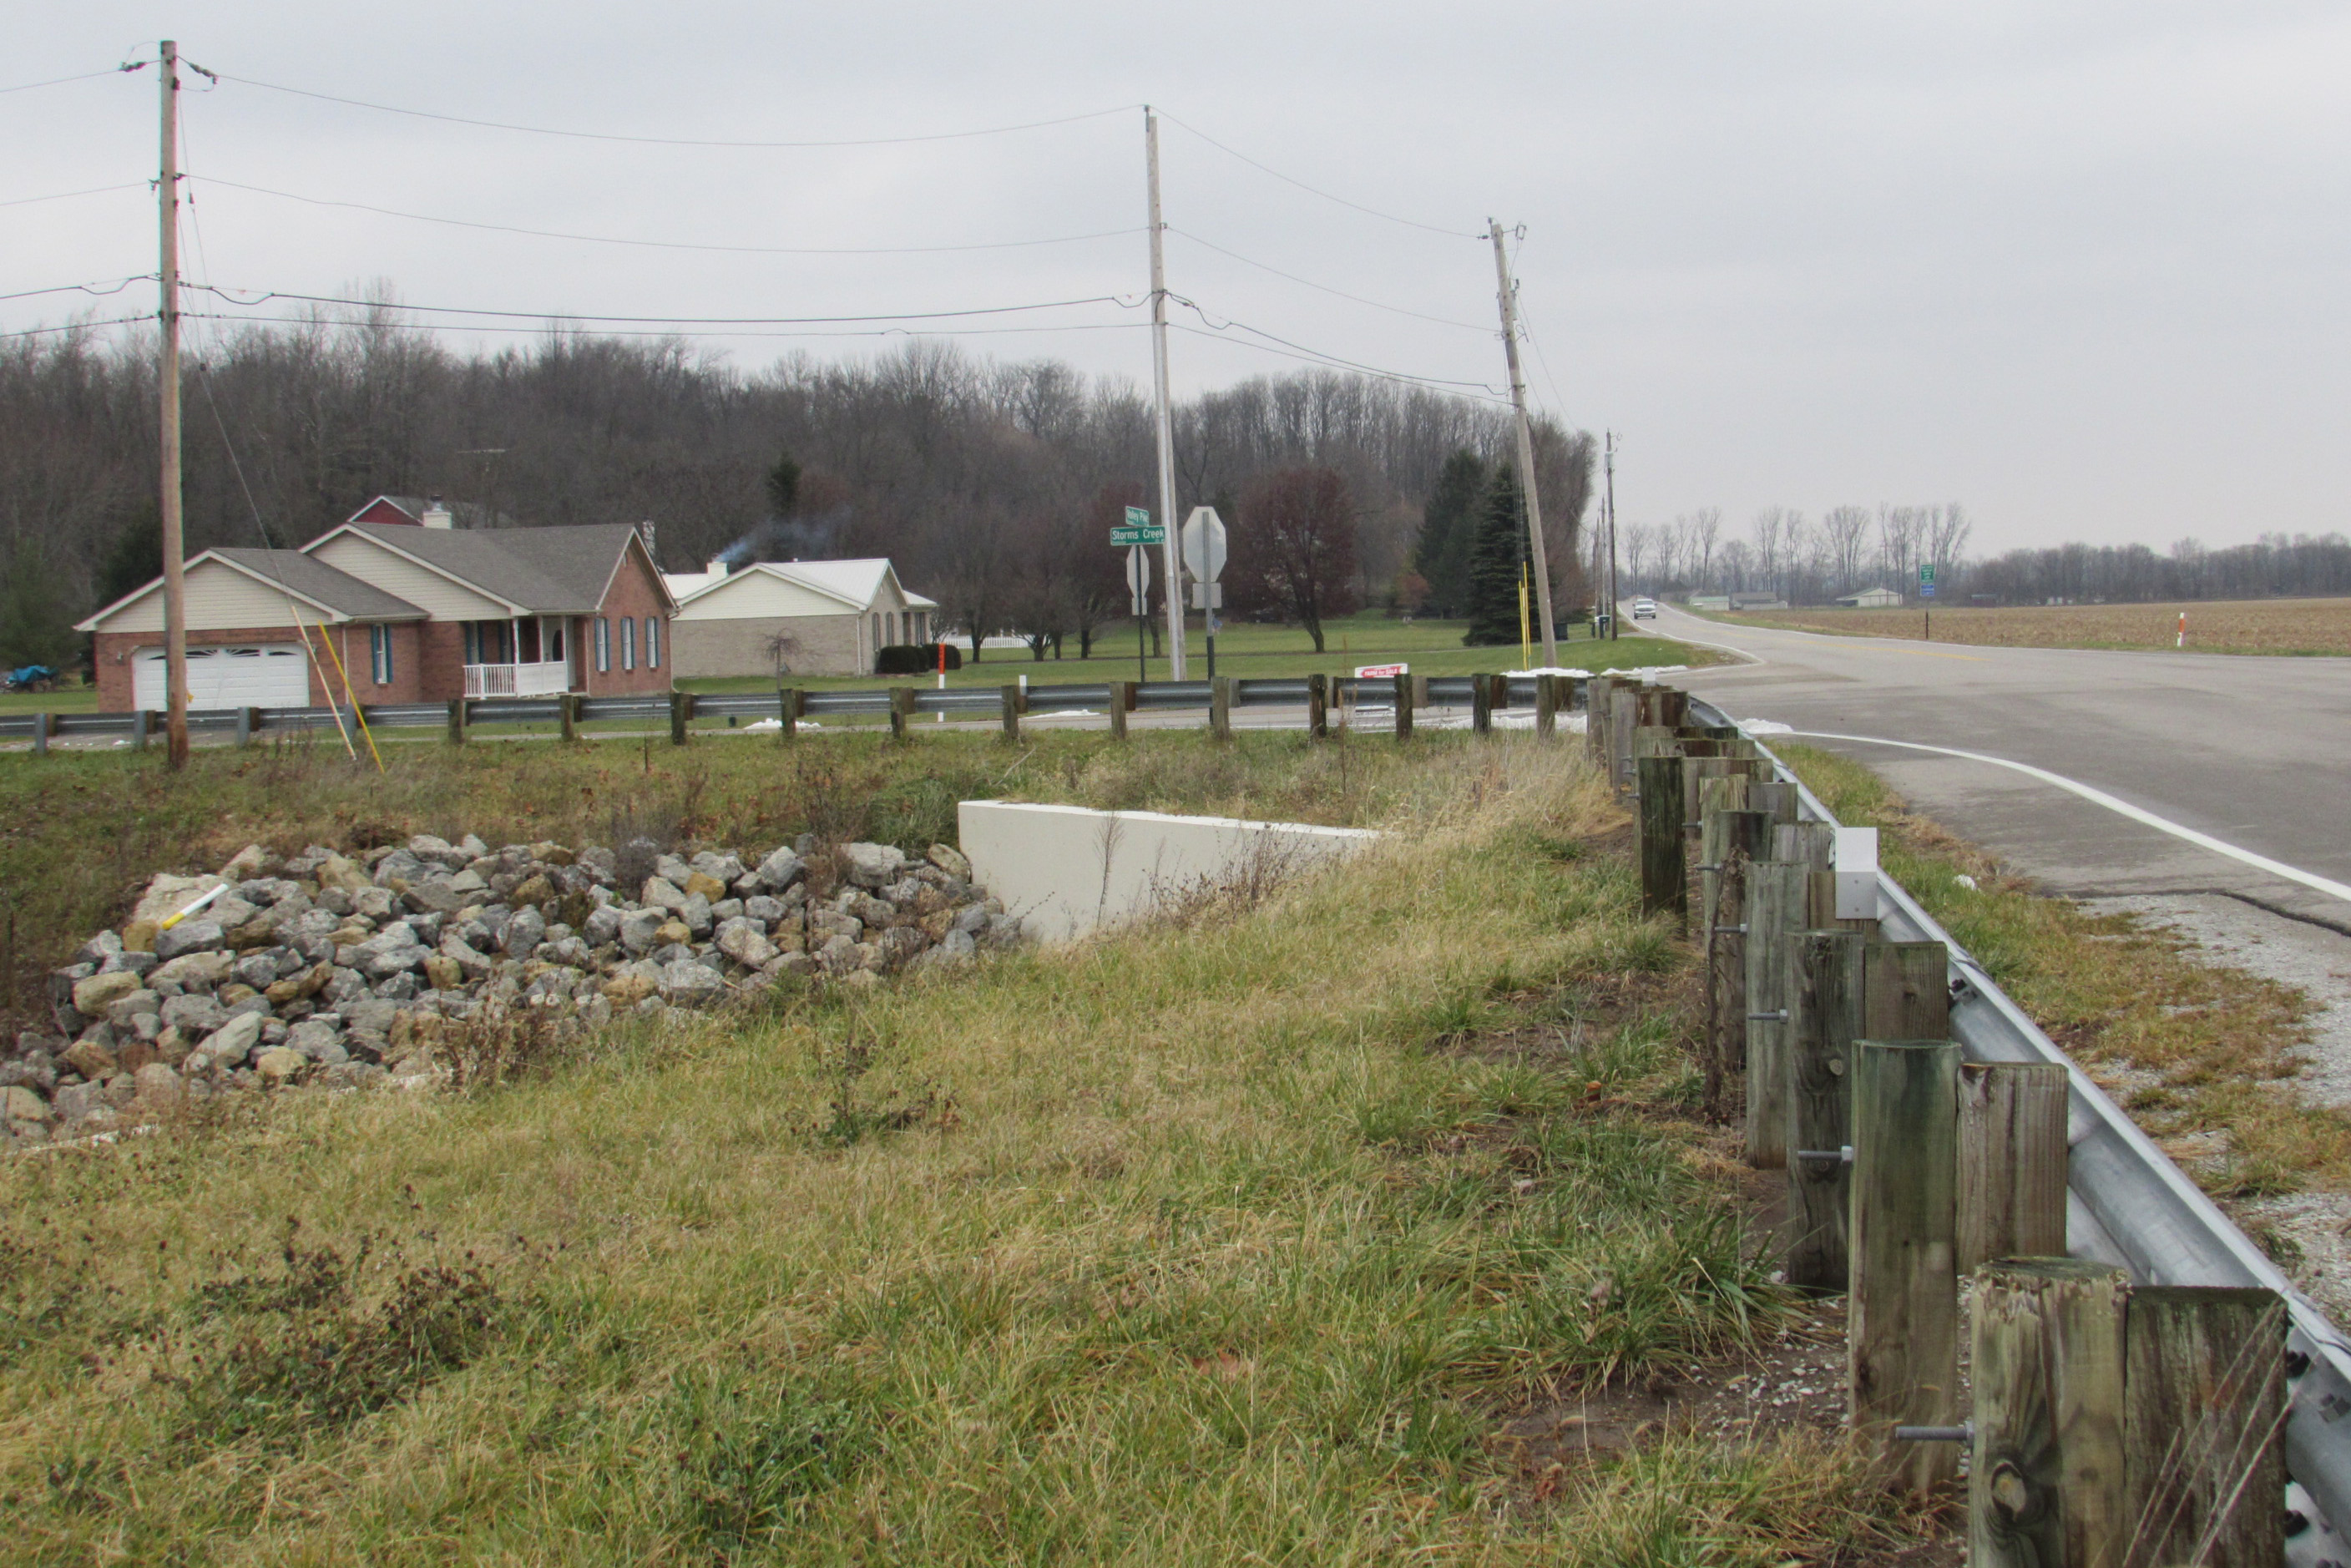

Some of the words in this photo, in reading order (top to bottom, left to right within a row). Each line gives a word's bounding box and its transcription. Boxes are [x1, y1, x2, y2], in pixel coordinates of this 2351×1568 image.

[1127, 509, 1139, 523] Valley
[1112, 530, 1139, 540] Storms
[1143, 529, 1165, 539] Creek
